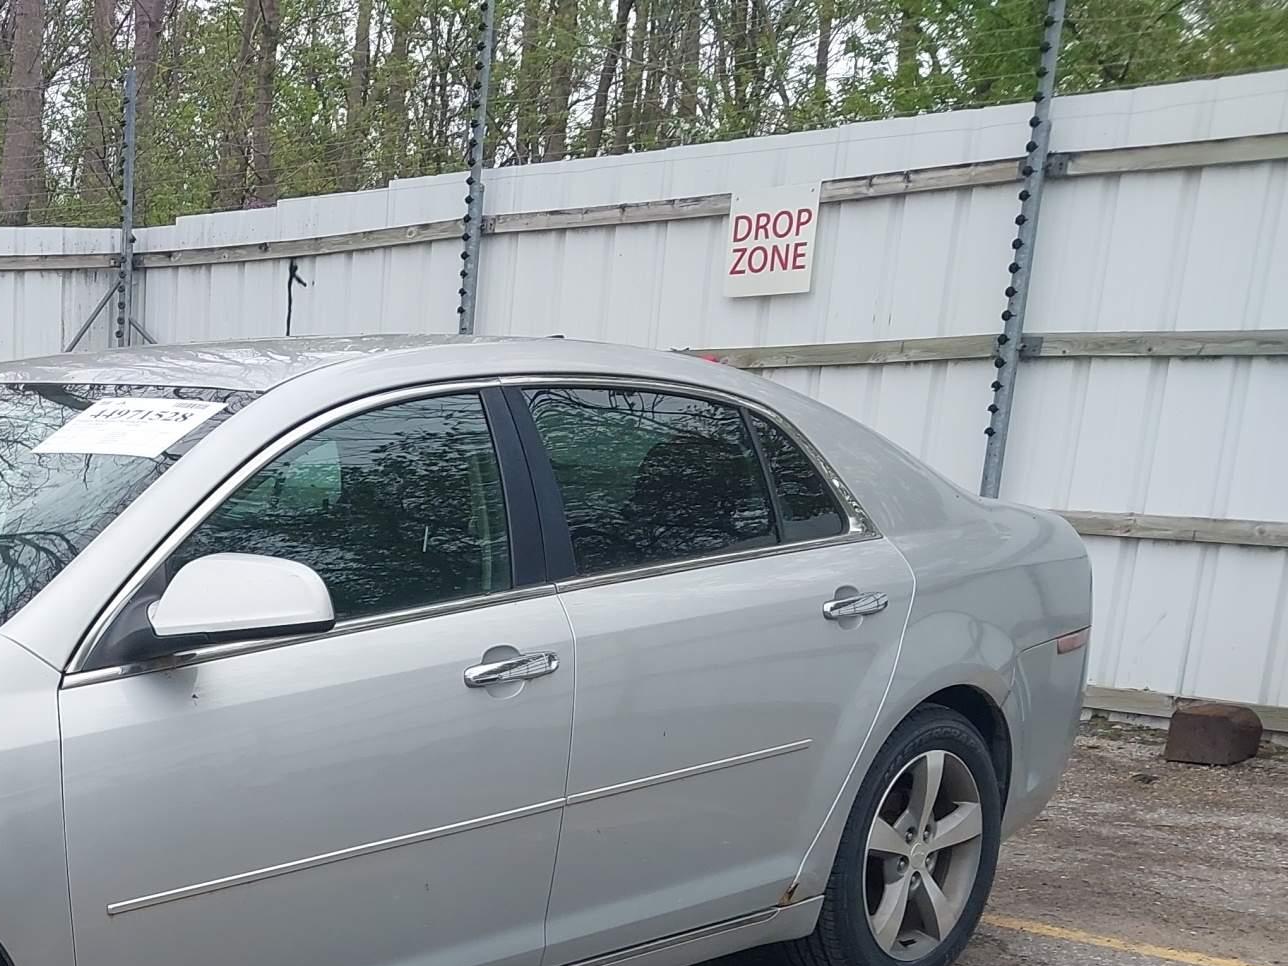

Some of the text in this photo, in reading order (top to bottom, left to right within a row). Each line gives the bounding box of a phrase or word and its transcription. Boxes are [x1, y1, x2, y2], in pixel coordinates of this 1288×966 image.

[732, 208, 813, 243] DROP
[729, 242, 808, 275] ZONE
[89, 408, 195, 423] 44971528
